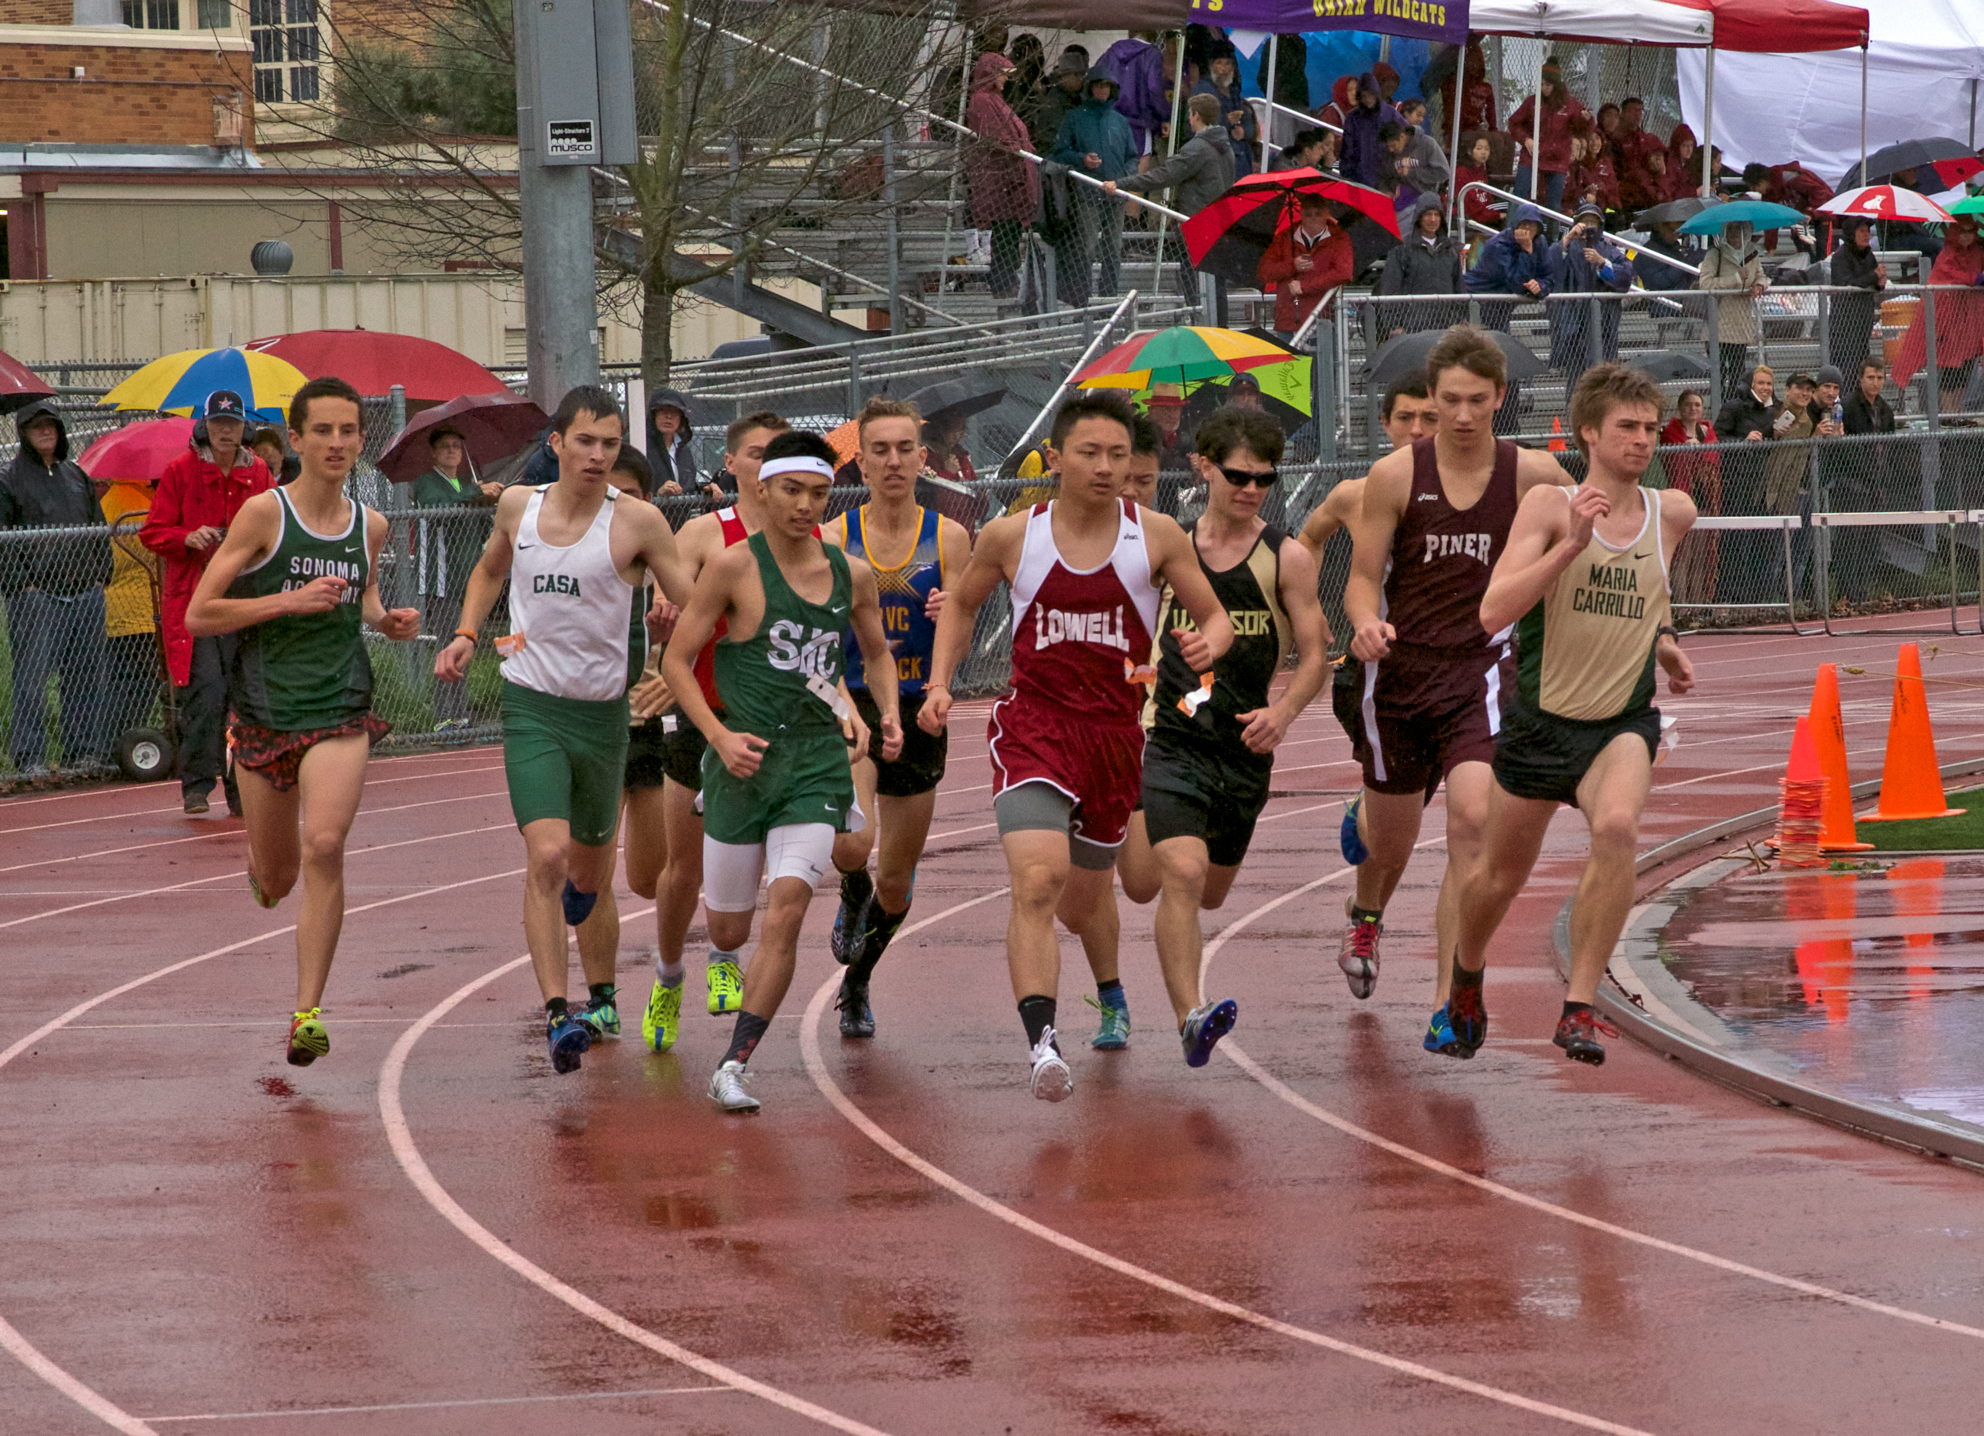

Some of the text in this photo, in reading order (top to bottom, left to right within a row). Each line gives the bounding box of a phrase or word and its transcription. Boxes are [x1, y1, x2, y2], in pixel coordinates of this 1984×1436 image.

[1373, 0, 1446, 26] WILDCATS
[1424, 533, 1492, 566] PINER
[290, 555, 360, 581] SONOMA
[1588, 563, 1638, 592] MARIA
[533, 574, 581, 598] CASA
[1572, 587, 1645, 619] CARRILLO
[1035, 601, 1130, 652] LOWELL
